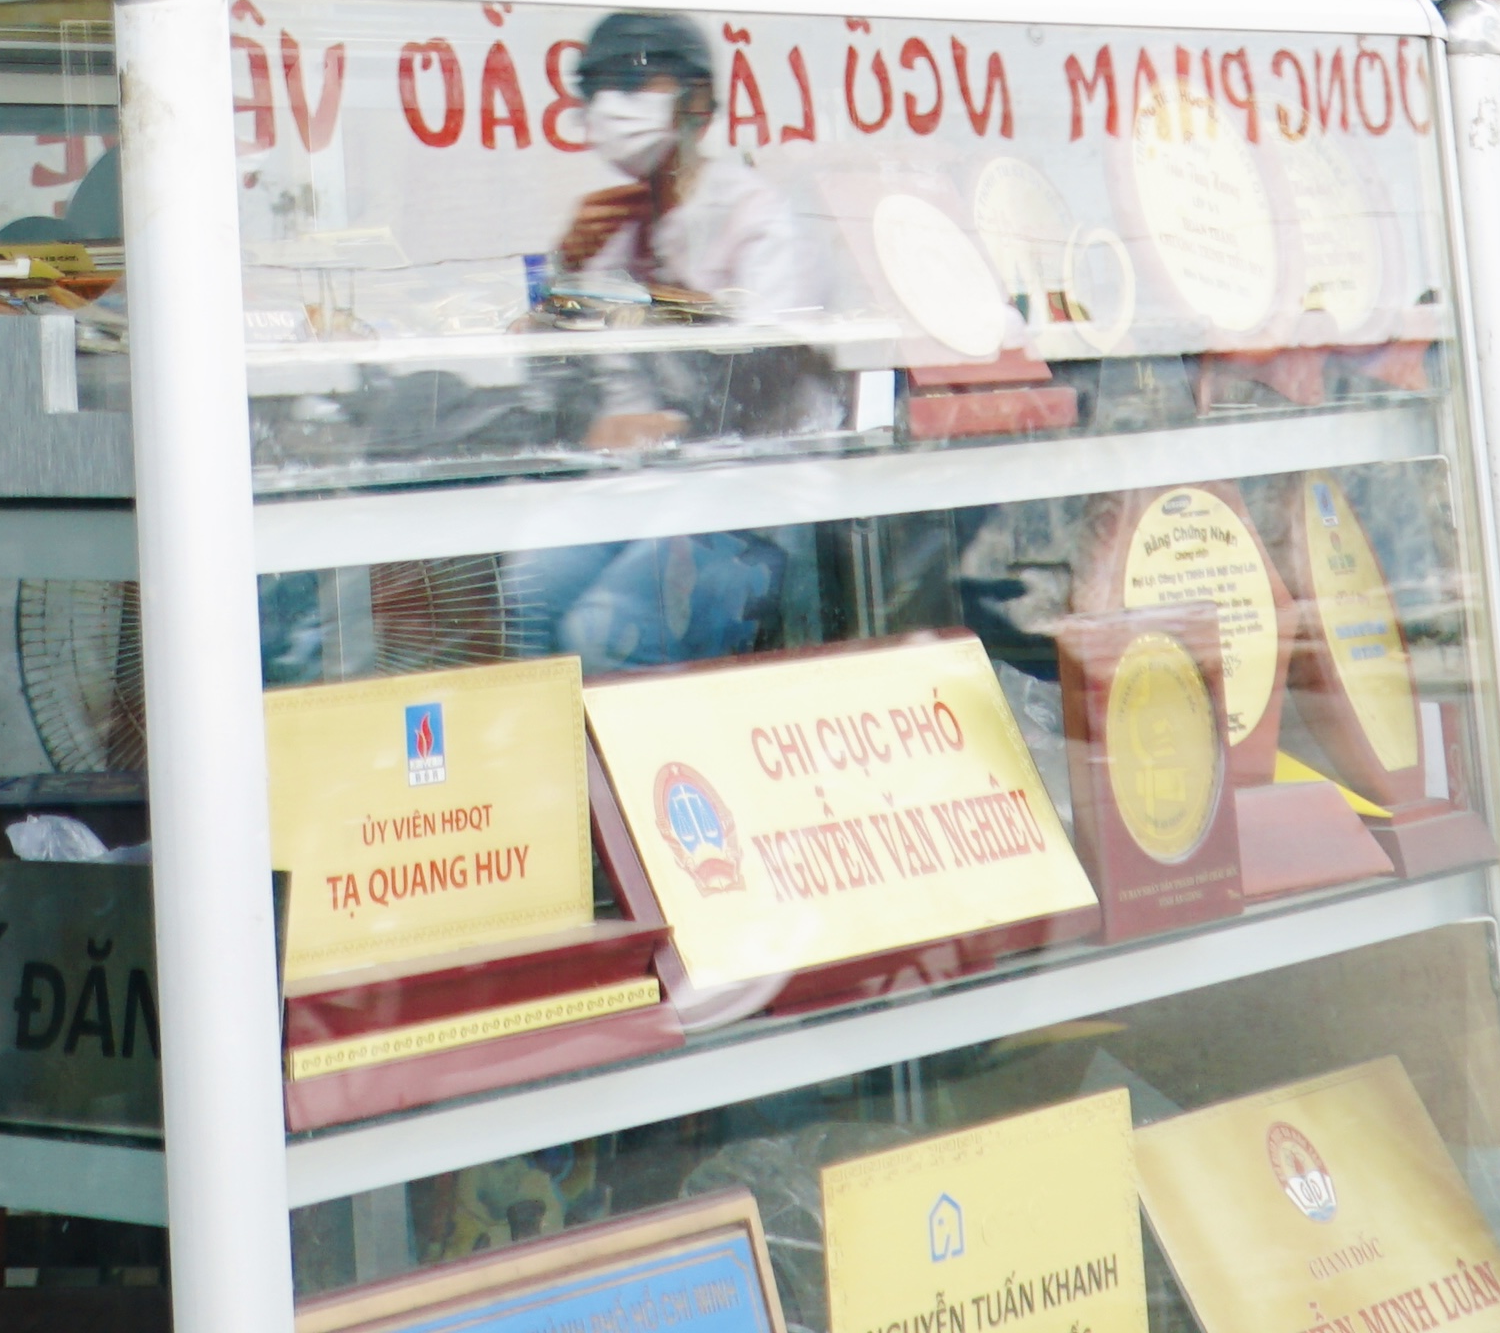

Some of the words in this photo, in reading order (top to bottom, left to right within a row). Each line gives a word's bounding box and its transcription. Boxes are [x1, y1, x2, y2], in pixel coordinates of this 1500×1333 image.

[750, 722, 819, 781] CHI
[815, 711, 893, 779] CỤC
[887, 686, 965, 758] PHÓ
[361, 809, 392, 850] ỦY
[393, 803, 440, 841] VIÊN
[441, 803, 494, 839] HĐQT
[750, 784, 886, 893] NGUYỄN
[867, 790, 948, 880] VĂN
[325, 874, 362, 918] TẠ
[367, 852, 469, 904] QUANG
[473, 844, 532, 888] HUY
[972, 1269, 1036, 1330] TUẤN
[1040, 1253, 1121, 1311] KHANH
